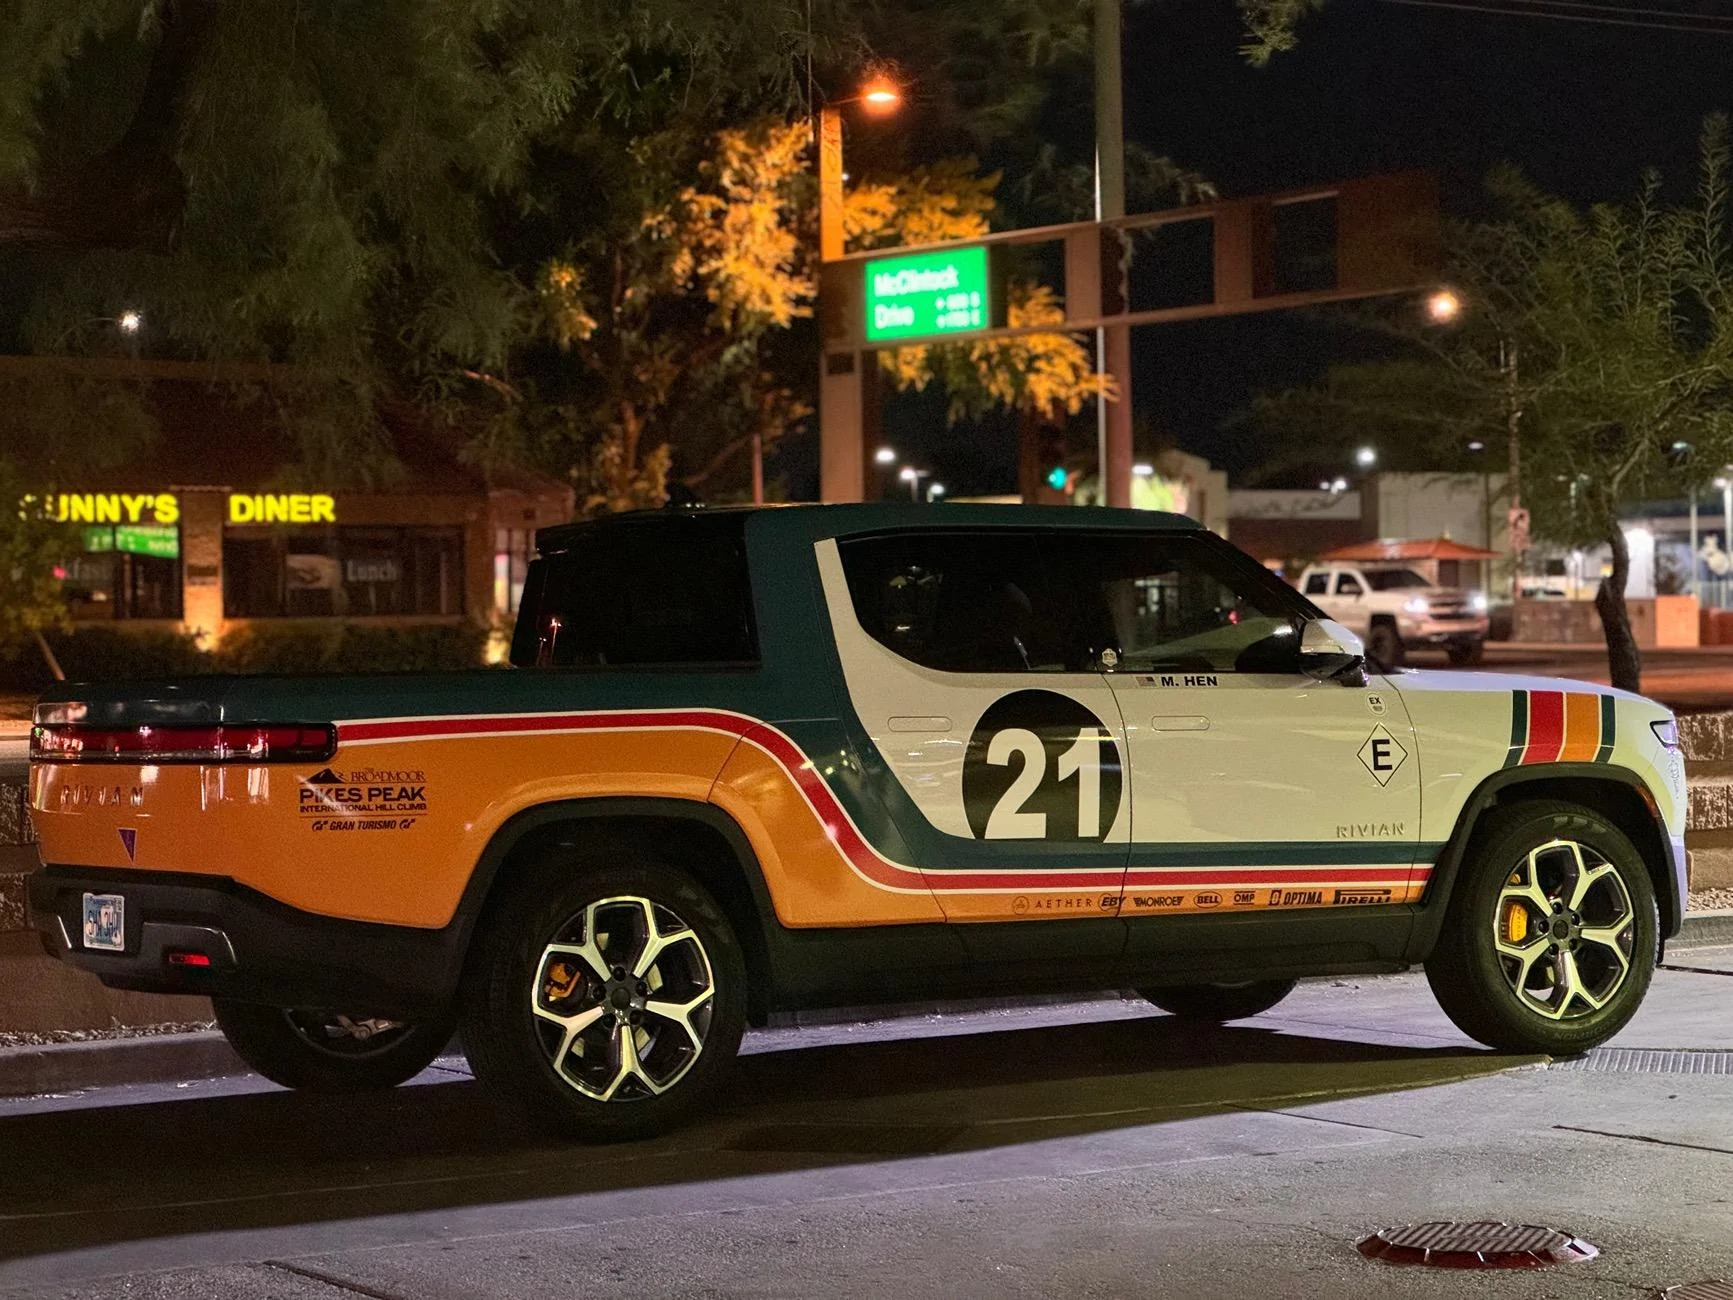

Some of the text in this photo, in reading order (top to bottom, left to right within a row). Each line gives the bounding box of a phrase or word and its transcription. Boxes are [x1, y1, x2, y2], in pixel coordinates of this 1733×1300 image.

[18, 493, 336, 523] UNNY'S DINER
[347, 559, 398, 581] Lunch
[1161, 675, 1218, 687] M. HEN
[1369, 697, 1382, 705] EX
[1371, 738, 1393, 771] E
[351, 770, 426, 782] BROADMOOR
[984, 727, 1100, 840] 21
[300, 786, 427, 804] PIKES PEAK
[300, 802, 427, 813] INTERNATIONAL HILL CLIMB
[329, 820, 354, 831] GRAN
[358, 819, 397, 830] TURISMO
[1336, 822, 1408, 839] RIVIAN
[1035, 896, 1126, 908] AETHER EBY
[1140, 889, 1391, 907] MONROE BELL OMP OPTIMA PIRELLI
